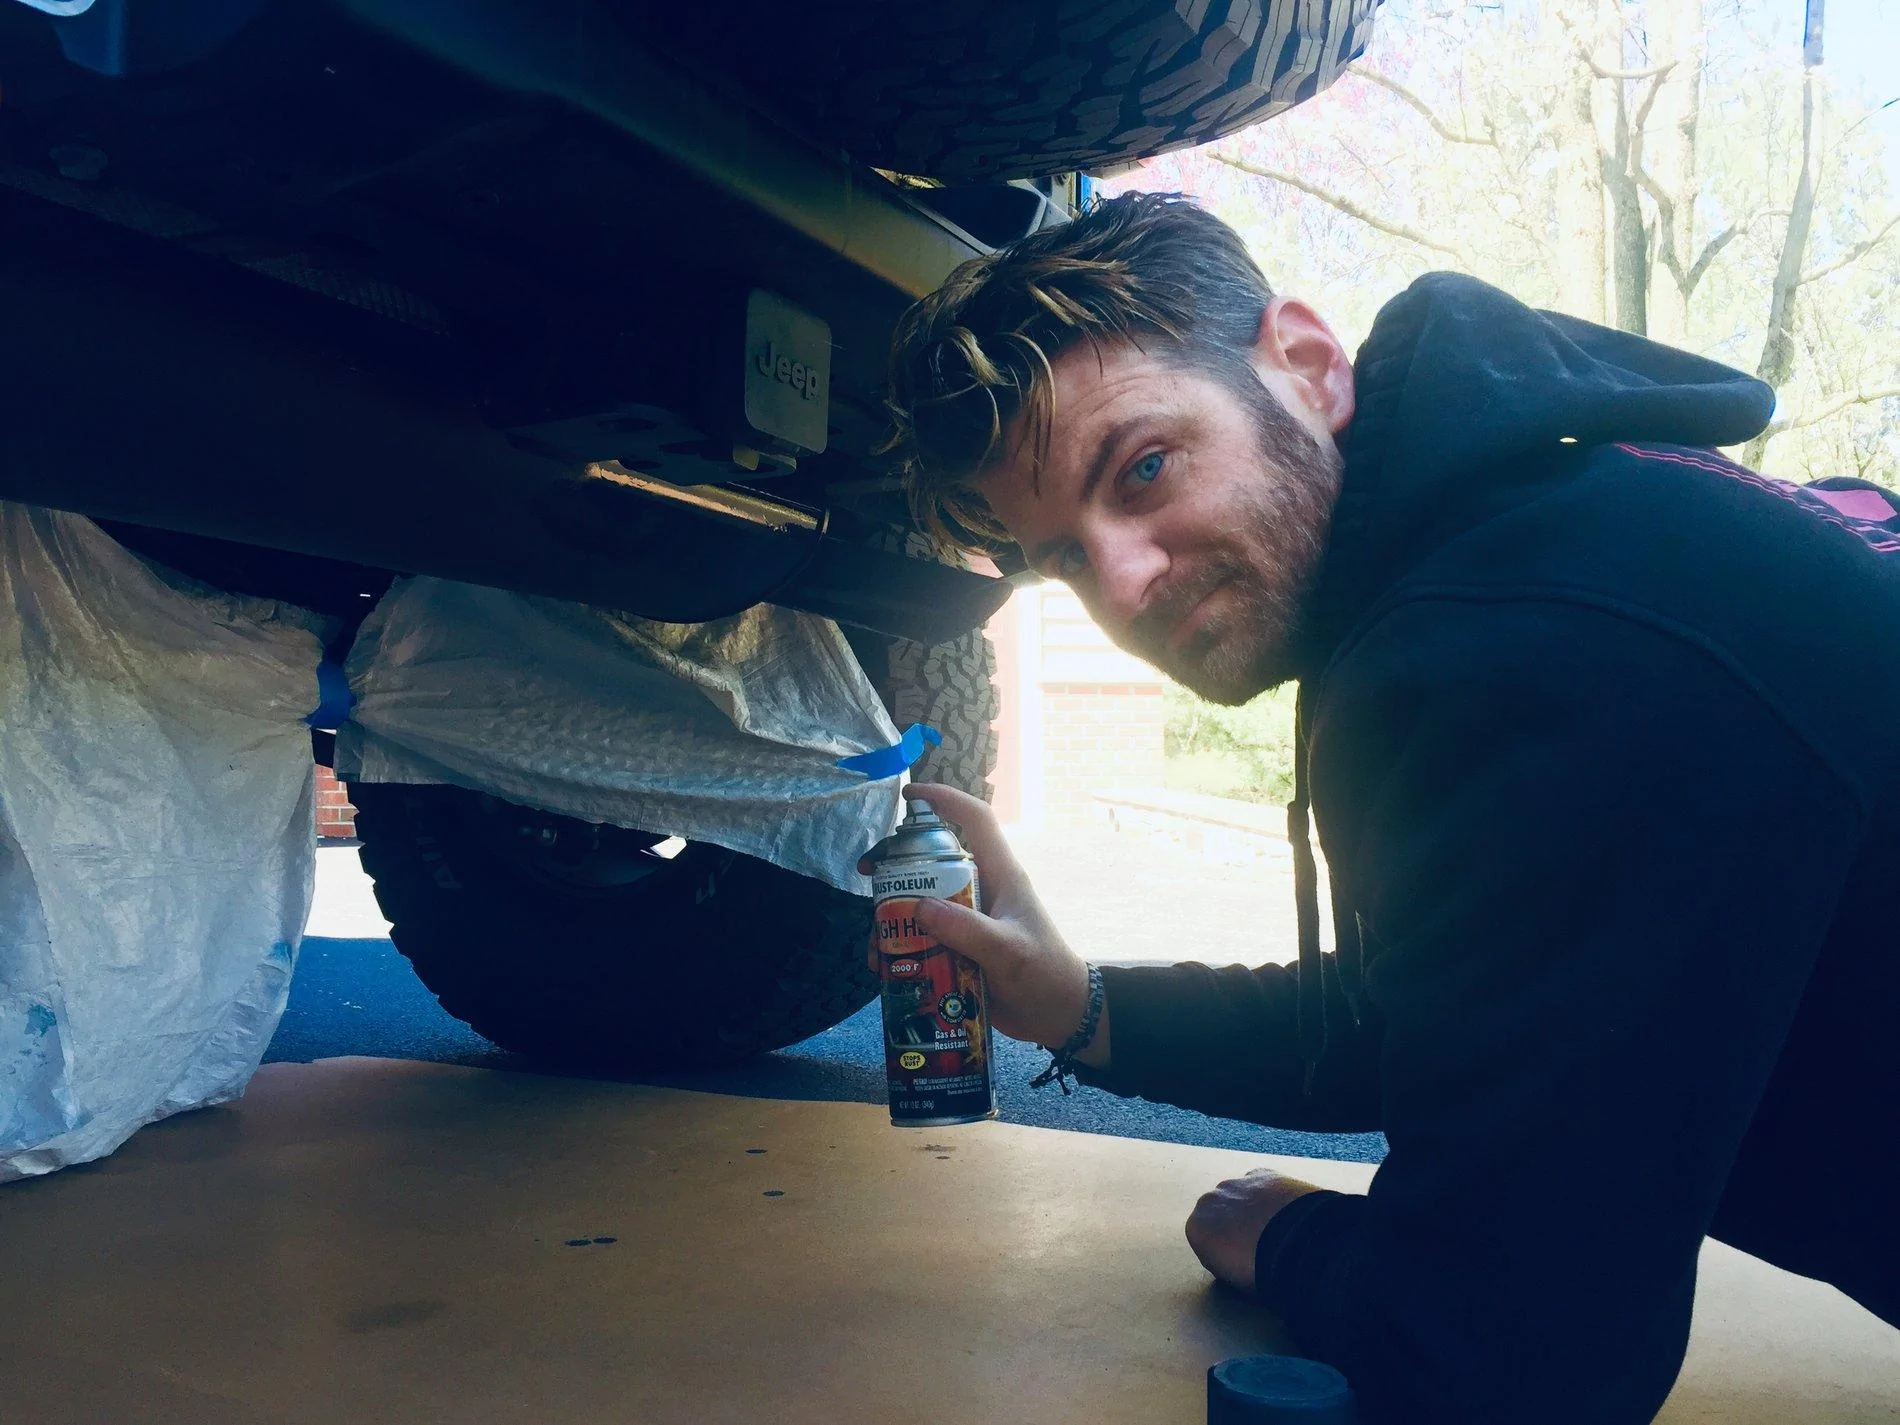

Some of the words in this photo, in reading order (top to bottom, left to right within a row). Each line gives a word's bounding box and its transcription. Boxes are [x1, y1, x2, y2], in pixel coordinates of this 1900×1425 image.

[756, 342, 820, 400] Jeep
[935, 1030, 949, 1039] Gas
[949, 1029, 957, 1038] &
[957, 1028, 967, 1038] Oil
[934, 1039, 969, 1051] Resistant
